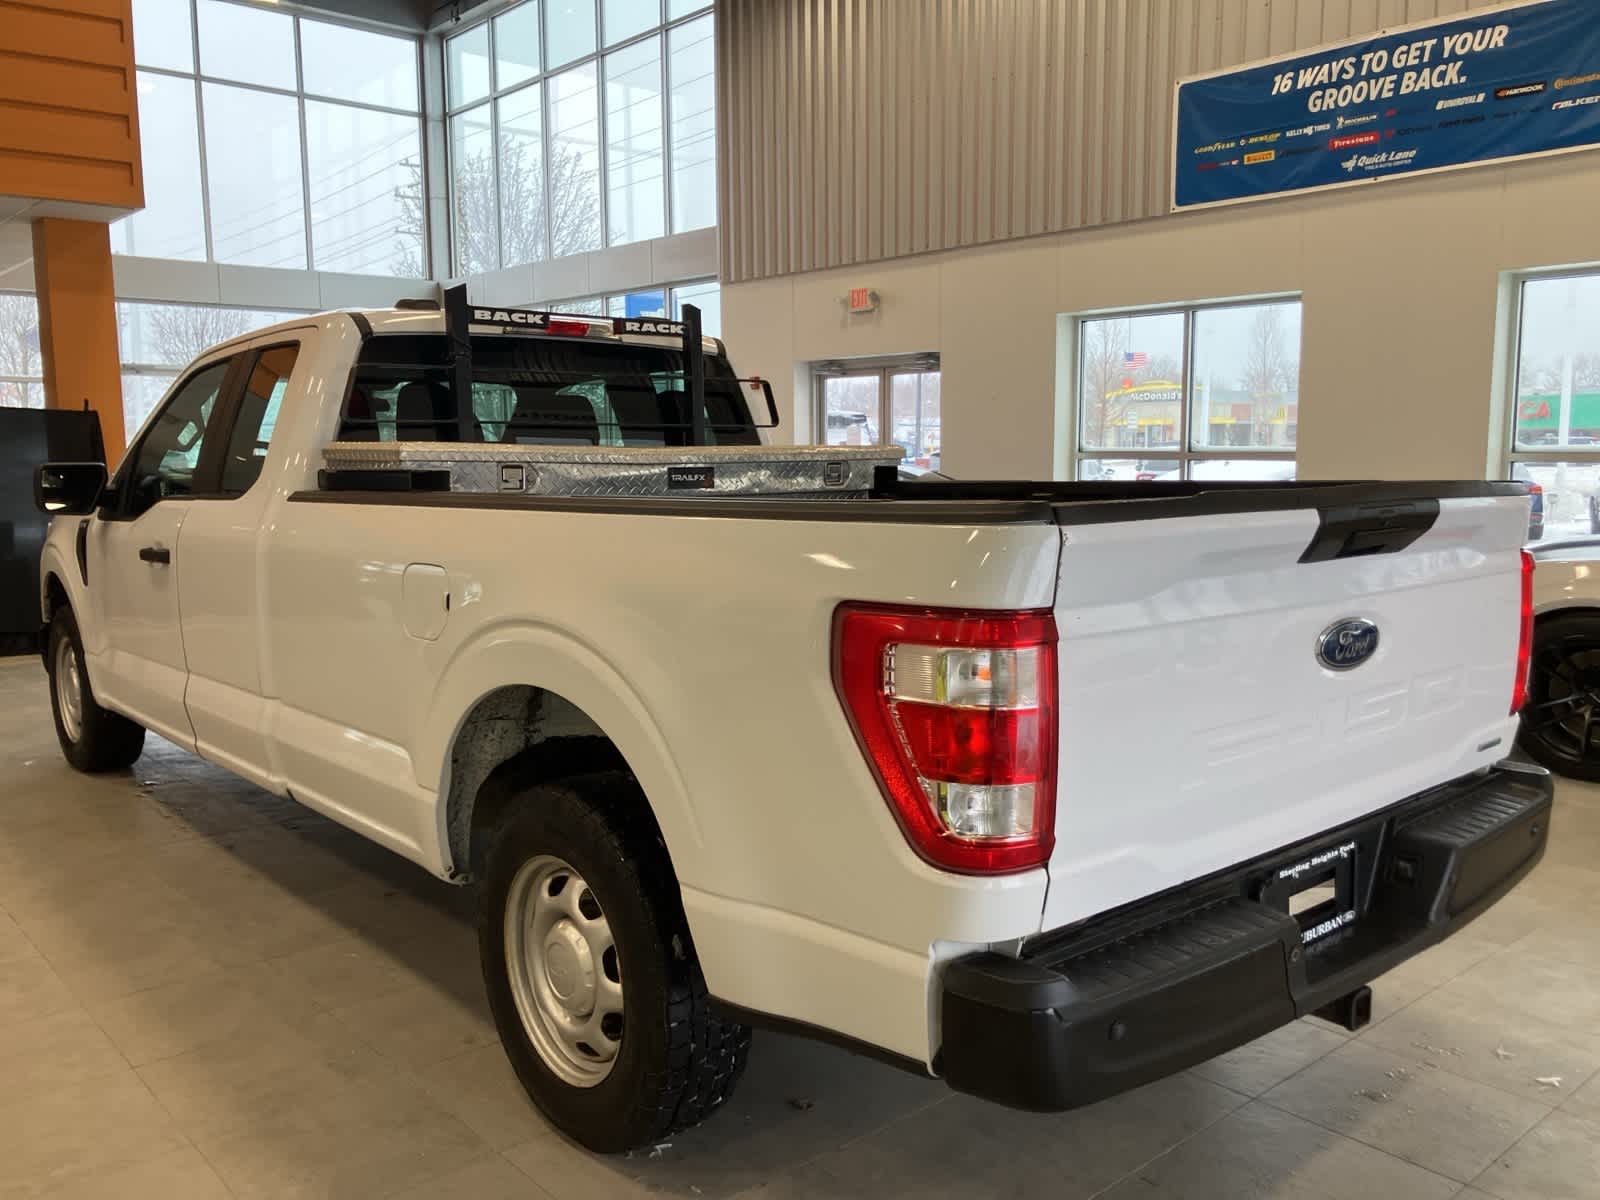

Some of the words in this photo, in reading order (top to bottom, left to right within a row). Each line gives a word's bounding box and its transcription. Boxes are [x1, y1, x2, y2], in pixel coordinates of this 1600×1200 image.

[1271, 72, 1294, 96] 16
[1297, 56, 1356, 89] WAYS
[1361, 50, 1388, 76] TO
[1392, 38, 1438, 69] GET
[1443, 24, 1509, 58] YOUR
[1308, 74, 1397, 113] GROOVE
[1400, 60, 1468, 95] BACK.
[1333, 135, 1375, 149] Firestone
[1357, 152, 1386, 168] Quick
[1388, 149, 1417, 161] Lane
[474, 309, 544, 325] BACK
[625, 321, 686, 335] RACK
[1280, 862, 1310, 879] Sterling
[1311, 850, 1339, 866] Heights
